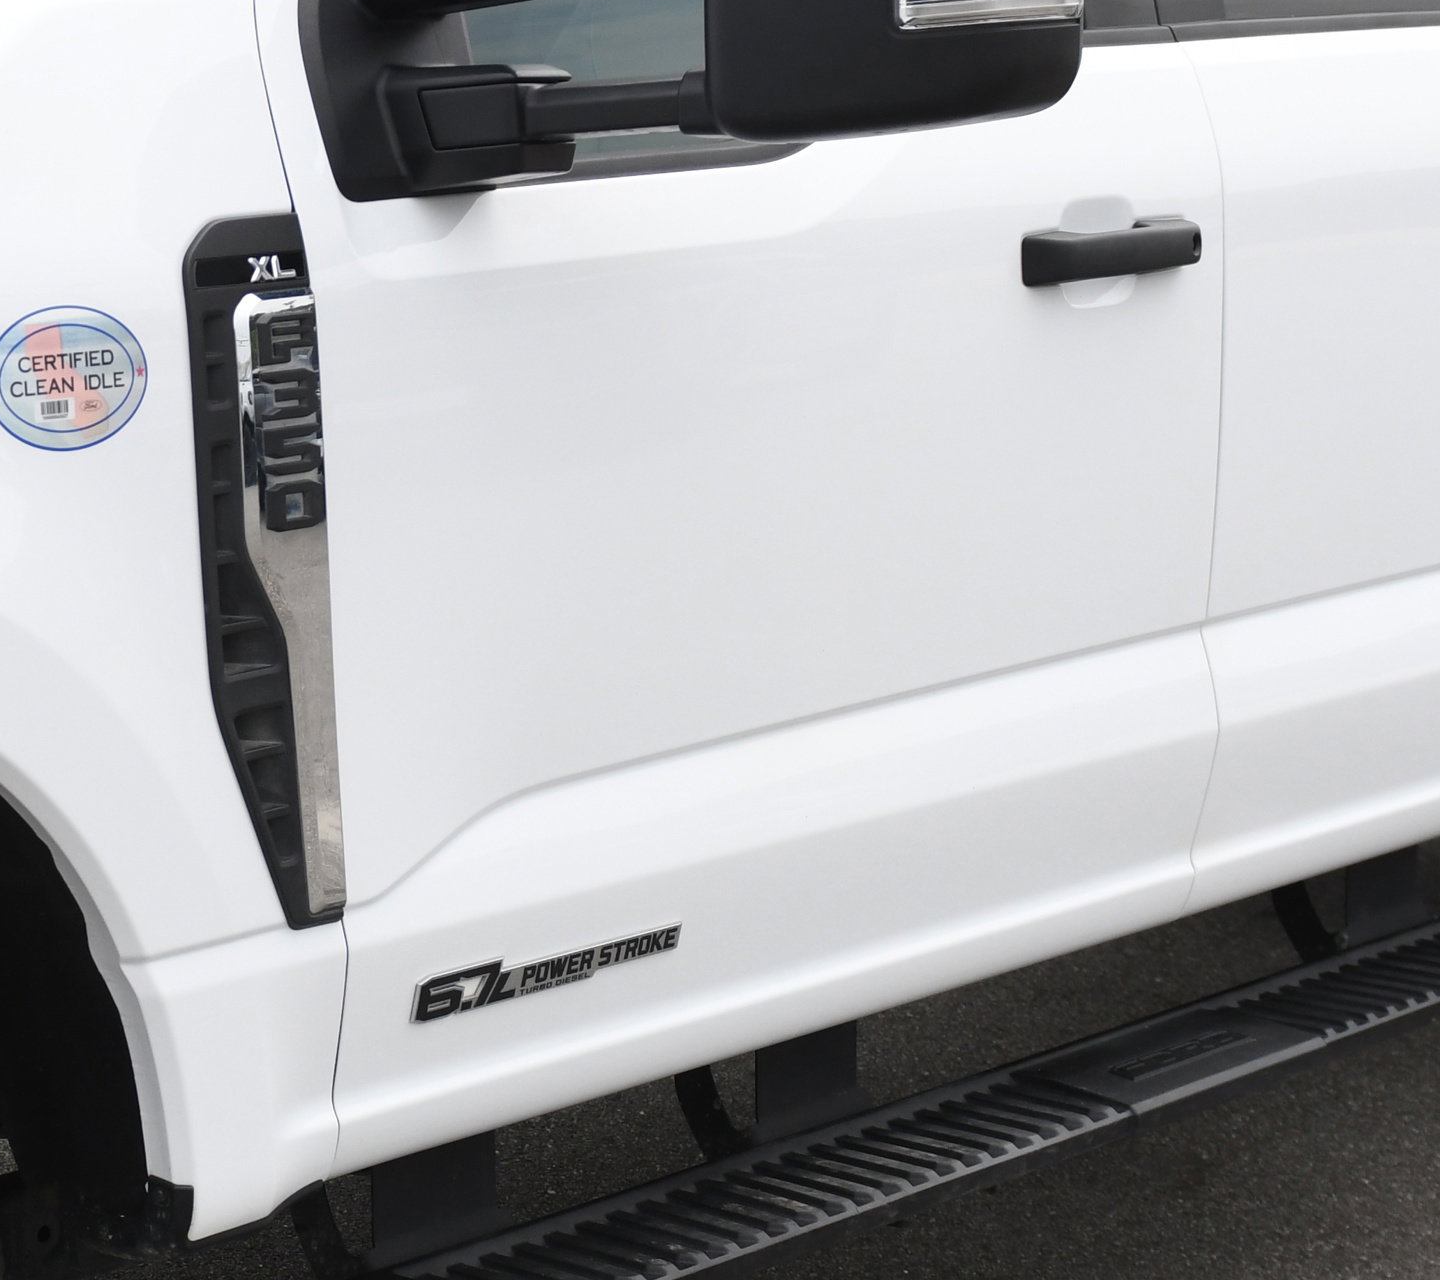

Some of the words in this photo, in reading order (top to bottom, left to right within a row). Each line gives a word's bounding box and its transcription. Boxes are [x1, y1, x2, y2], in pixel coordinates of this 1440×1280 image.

[247, 254, 296, 282] XL
[17, 349, 115, 374] CERTIFIED
[9, 377, 75, 398] CLEAN
[83, 371, 126, 391] IDLE
[256, 312, 325, 532] F350
[415, 960, 516, 1022] 6.7L
[520, 949, 596, 988] POWER
[597, 927, 678, 967] STROKE
[520, 982, 553, 996] TURBO
[555, 971, 591, 987] DIESEL
